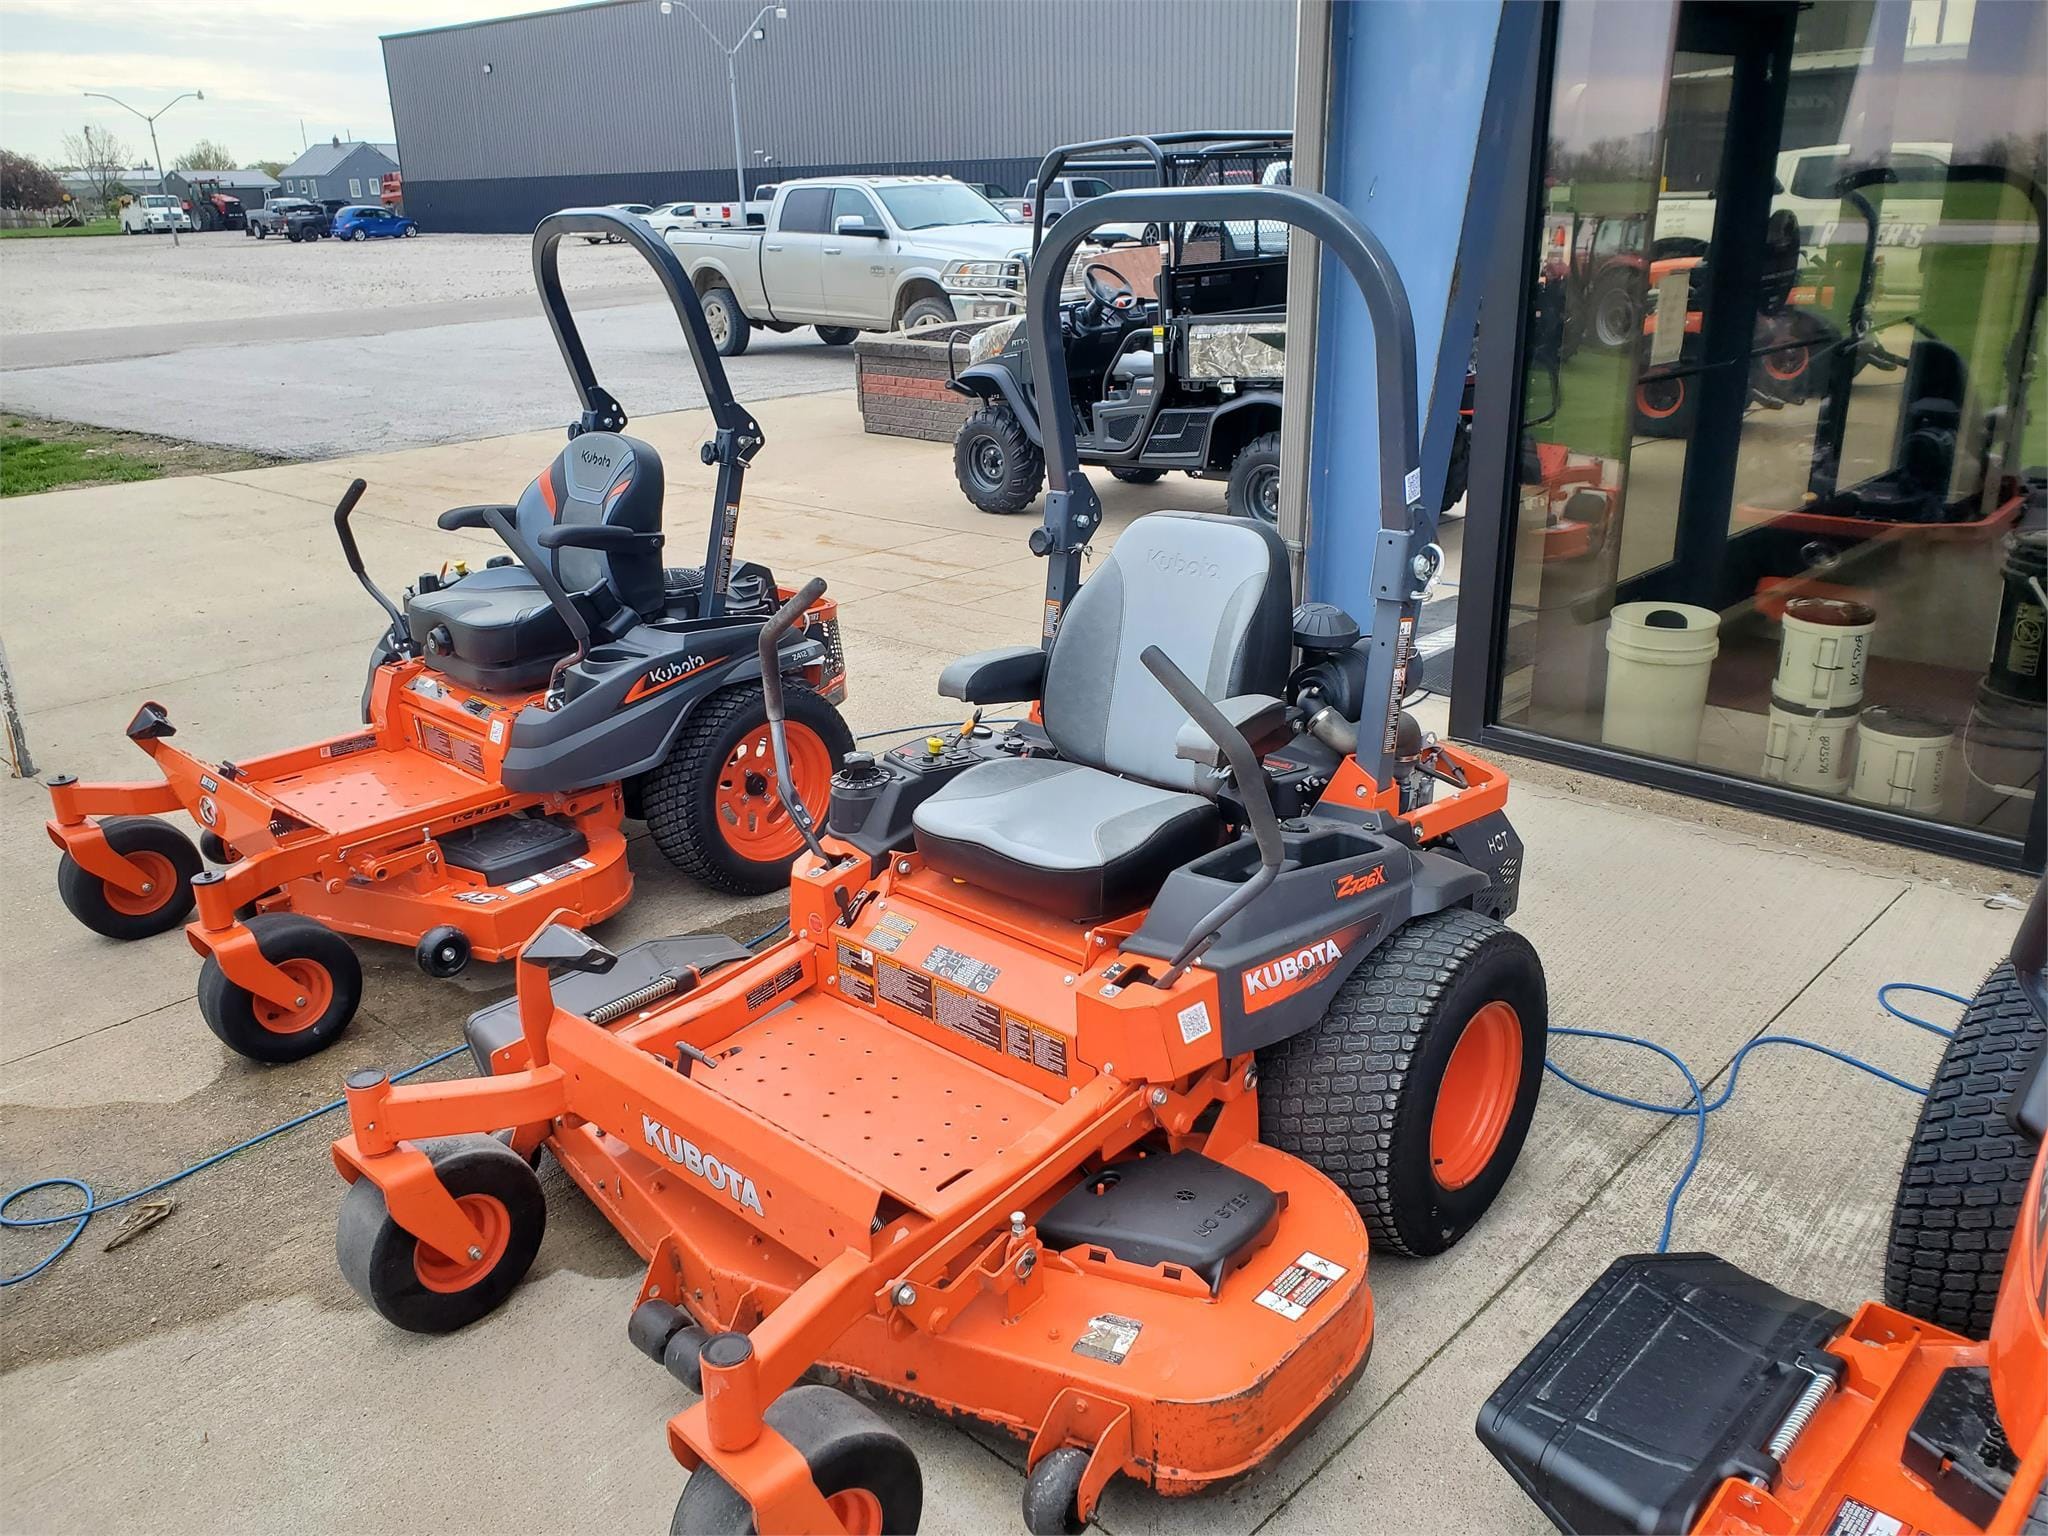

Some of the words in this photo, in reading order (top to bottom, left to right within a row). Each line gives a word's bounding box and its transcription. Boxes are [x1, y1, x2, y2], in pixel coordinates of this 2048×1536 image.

[581, 449, 611, 468] Kubota
[1147, 548, 1220, 578] Kubota
[649, 655, 705, 683] Kubota
[1487, 831, 1508, 855] HOT
[1336, 864, 1385, 898] Z726X
[1245, 938, 1344, 995] KUBOTA
[641, 1113, 765, 1217] KUBOTA
[1193, 1218, 1219, 1237] NO
[1214, 1193, 1250, 1219] STEP
